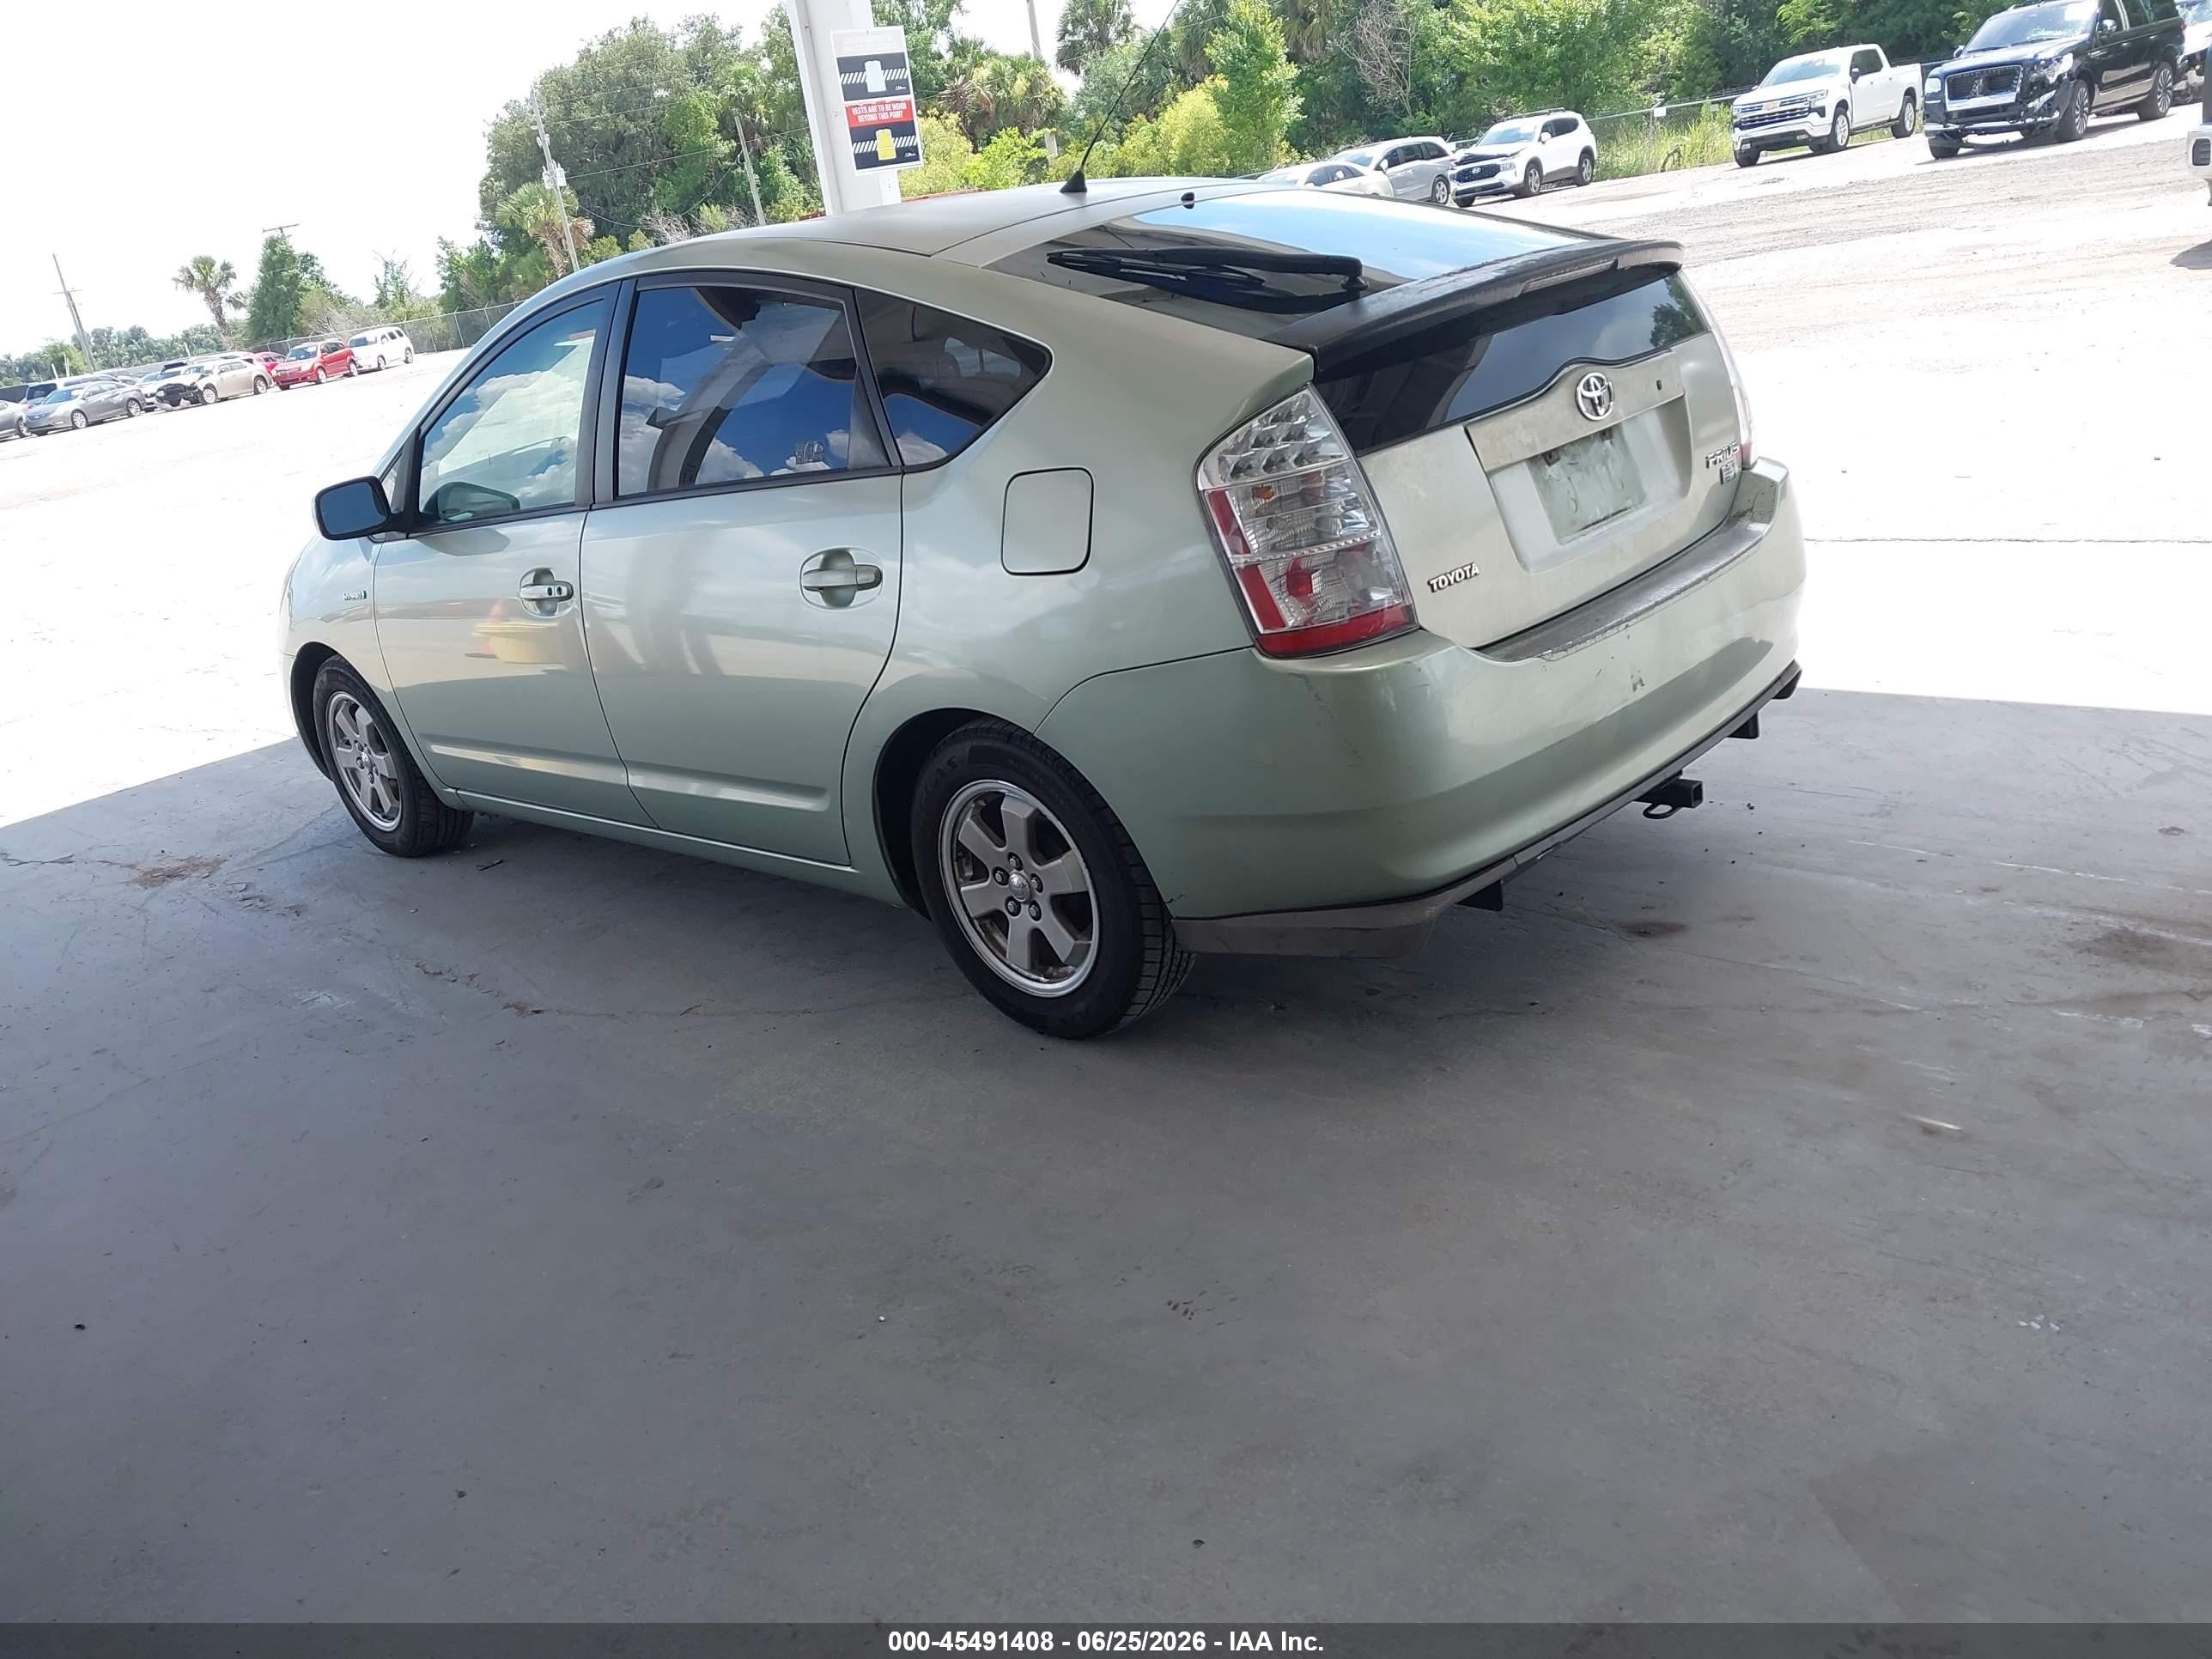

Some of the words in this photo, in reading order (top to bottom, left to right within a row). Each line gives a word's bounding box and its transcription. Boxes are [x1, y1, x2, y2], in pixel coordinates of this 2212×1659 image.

[851, 106, 868, 116] VESTS
[867, 104, 878, 113] ARE
[878, 103, 885, 112] TO
[884, 102, 892, 111] BE
[892, 102, 907, 111] WORN
[857, 113, 878, 123] BEYOND
[889, 110, 903, 119] POINT
[1705, 441, 1740, 469] PRIUS
[1427, 562, 1480, 592] TOYOTA
